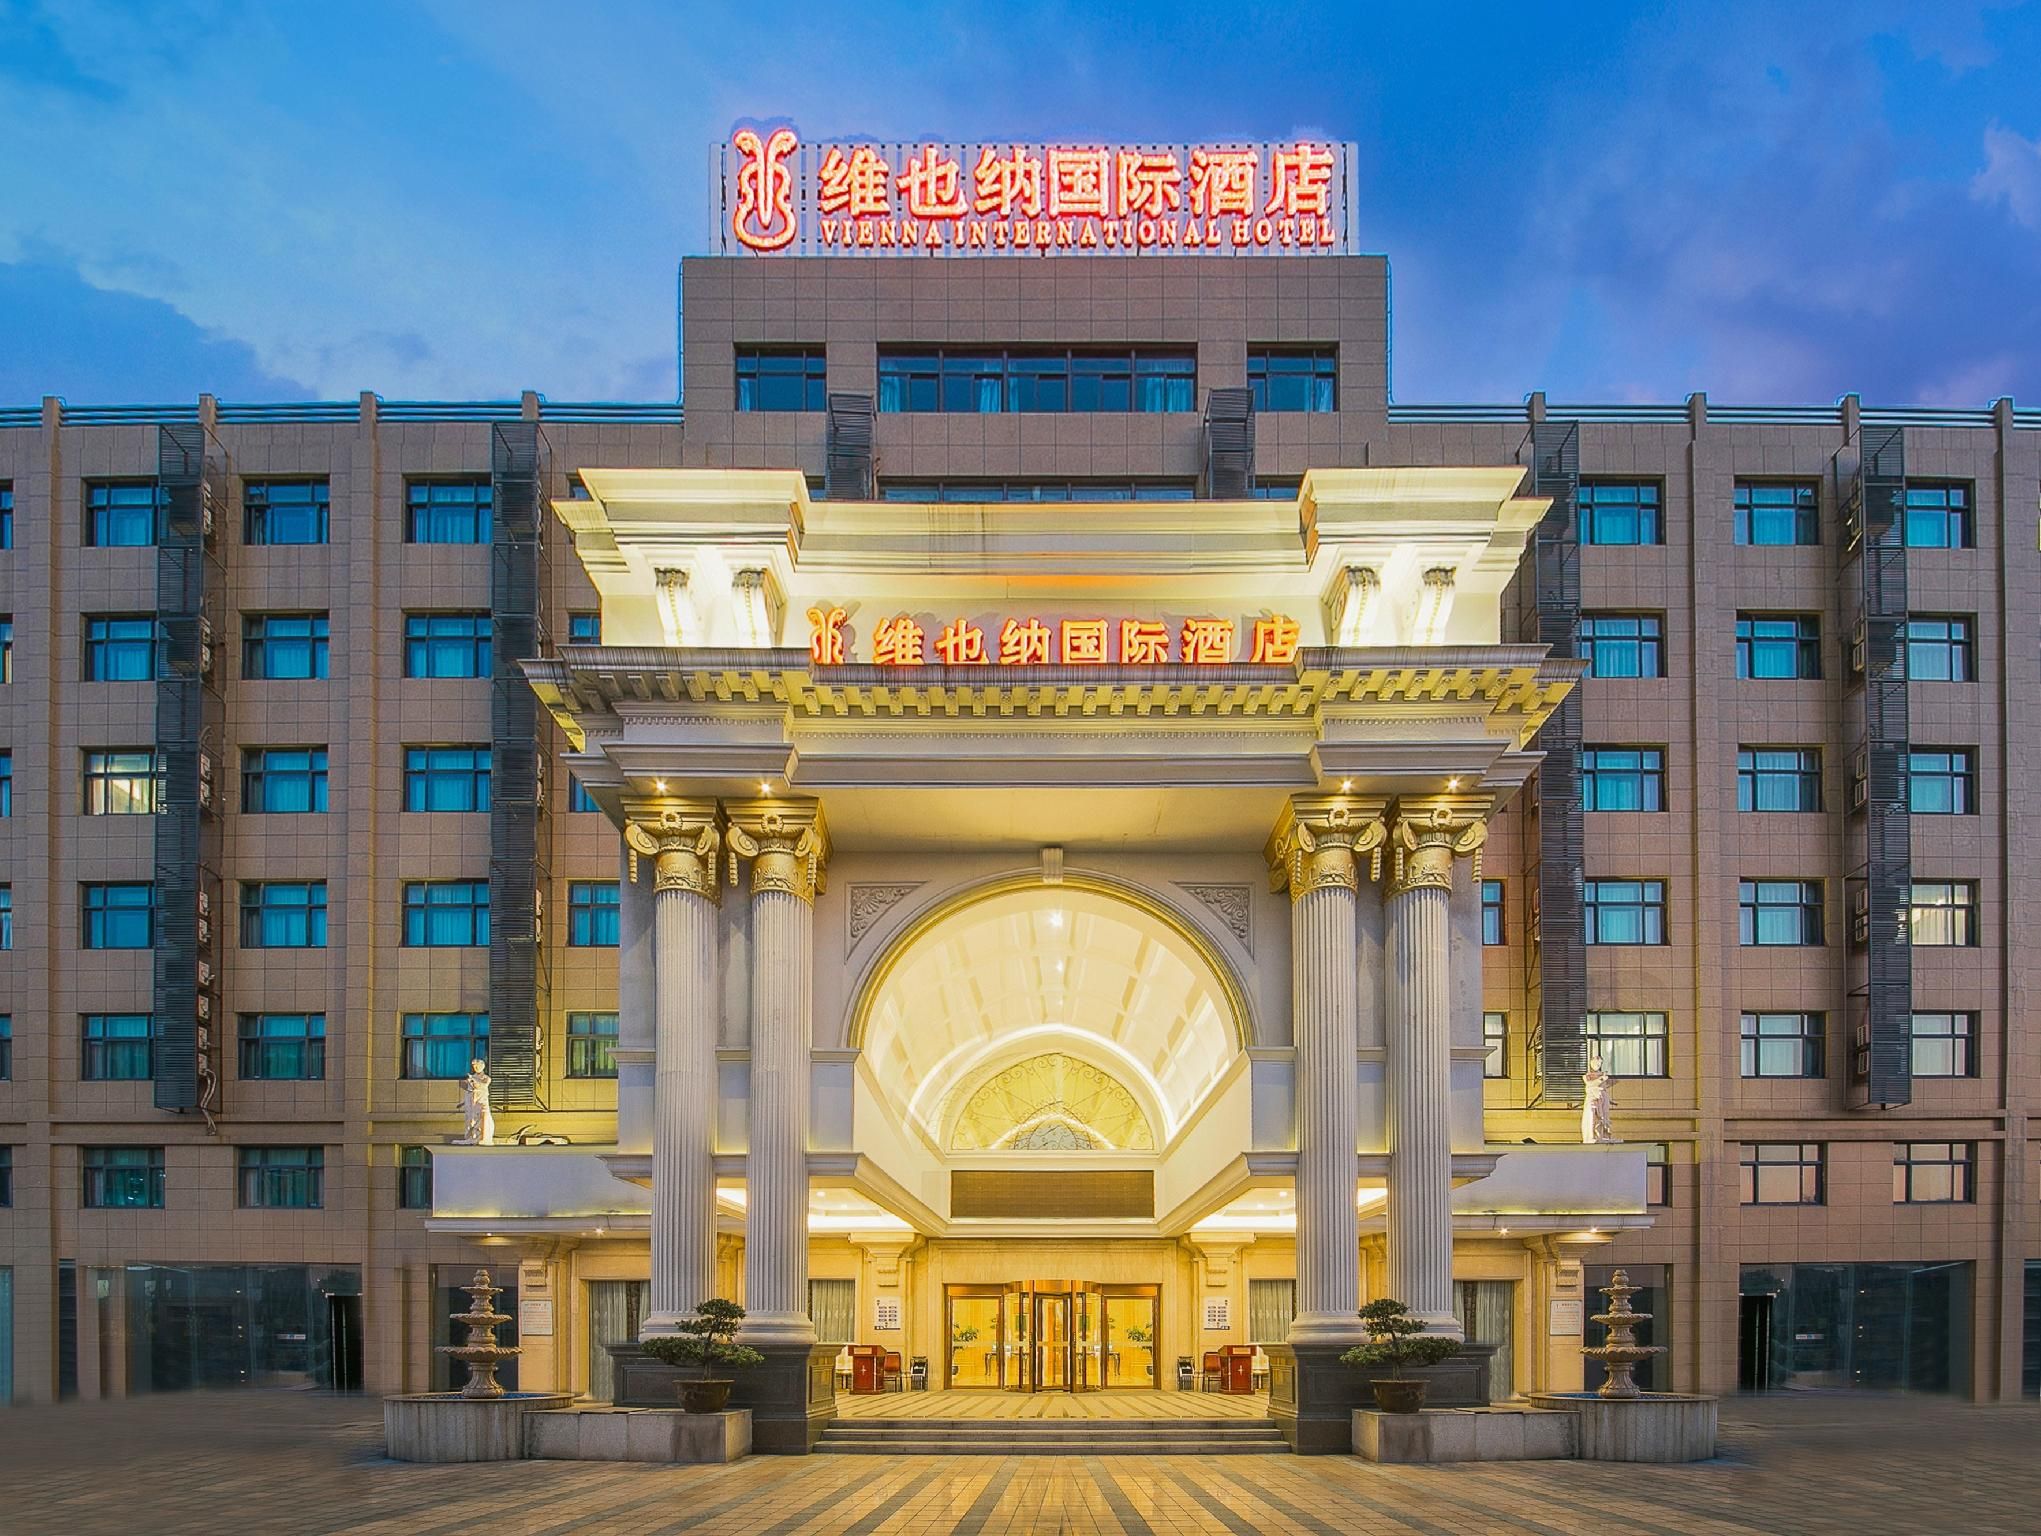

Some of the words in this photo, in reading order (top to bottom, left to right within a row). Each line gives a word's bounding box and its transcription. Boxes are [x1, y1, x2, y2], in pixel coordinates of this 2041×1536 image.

[819, 143, 1335, 217] 维也纳国际酒店
[820, 219, 943, 248] VIENNA
[953, 218, 1222, 248] INTERNATIONAL
[1231, 216, 1336, 246] HOTEL
[872, 615, 1300, 664] 维也纳国际酒店
